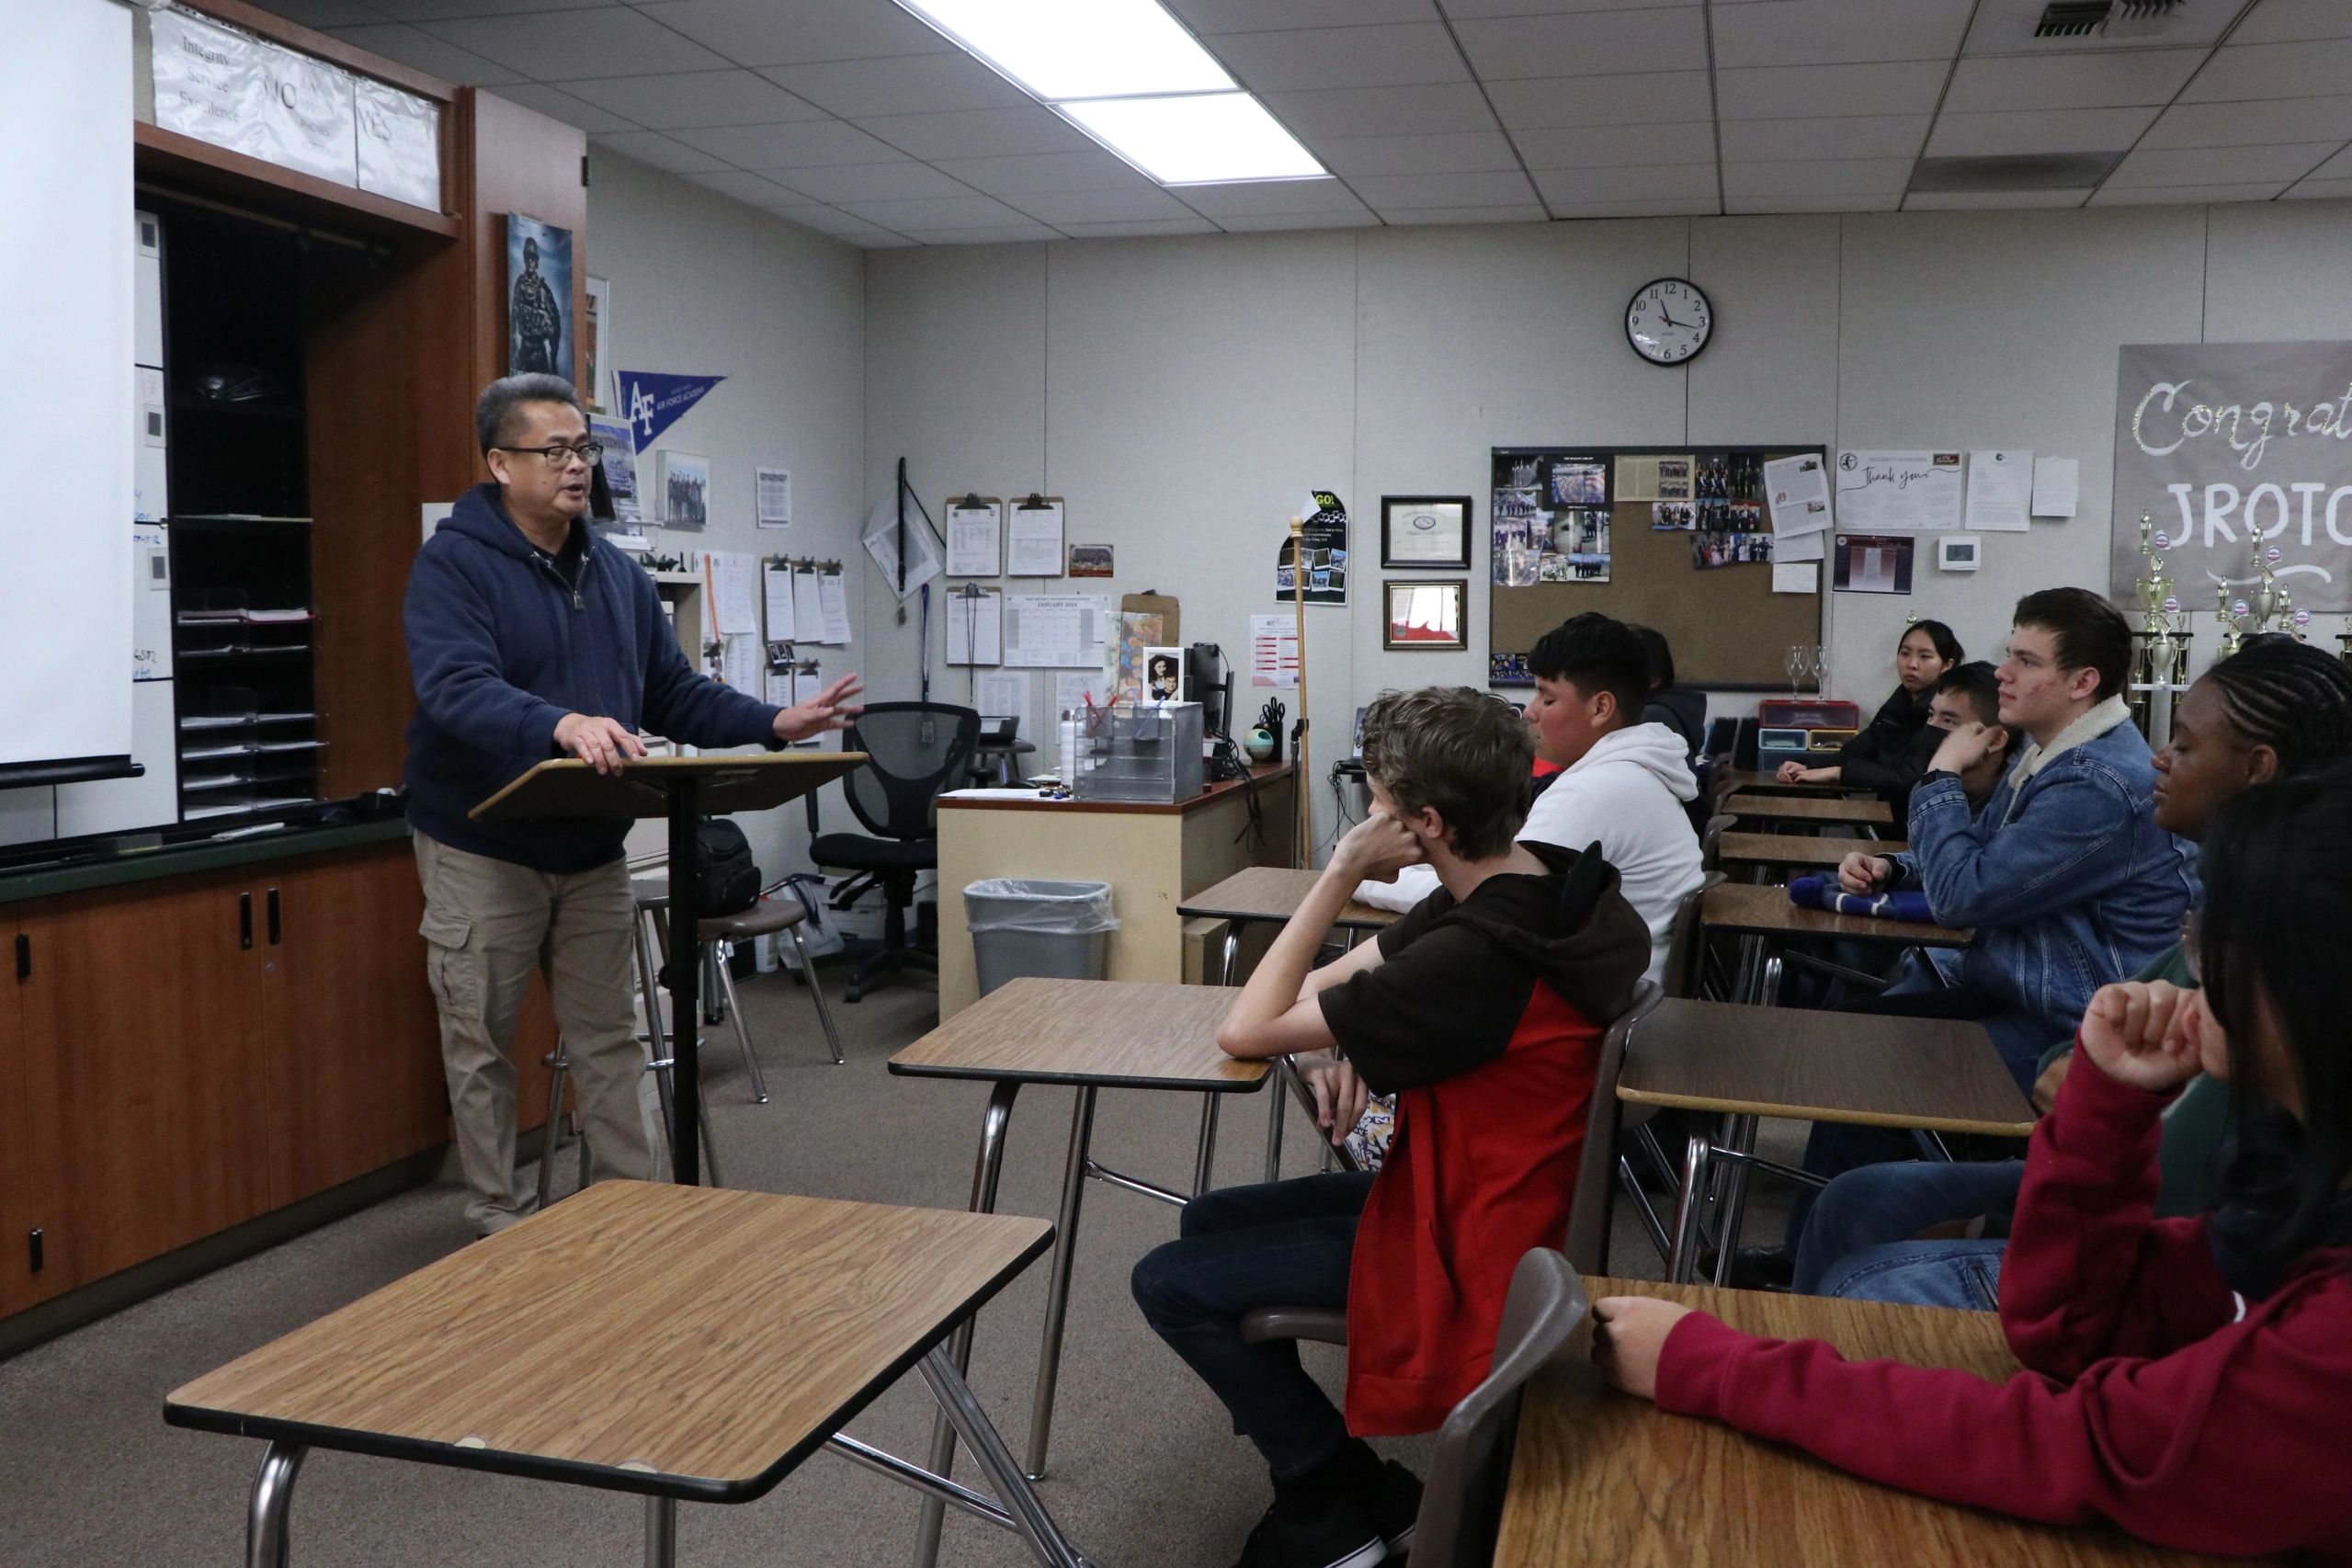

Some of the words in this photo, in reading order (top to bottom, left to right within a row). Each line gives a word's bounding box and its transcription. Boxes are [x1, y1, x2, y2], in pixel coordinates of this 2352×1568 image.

[183, 36, 231, 66] Integrity
[187, 66, 229, 93] Service
[264, 77, 297, 110] NO
[179, 91, 240, 122] Excellence
[359, 108, 392, 142] YES
[1650, 289, 1659, 300] 11
[1665, 283, 1676, 294] 12
[1683, 289, 1688, 300] 1
[1635, 300, 1646, 312] 10
[1694, 300, 1701, 312] 2
[1631, 316, 1639, 326] 9
[1699, 316, 1706, 328] 3
[1692, 332, 1699, 343] 4
[1649, 345, 1655, 356] 7
[1664, 348, 1671, 359] 6
[1679, 345, 1687, 356] 5
[656, 401, 666, 411] AIR
[665, 393, 683, 407] FORCE
[683, 386, 704, 401] ACADEMY
[630, 381, 654, 437] AF
[1862, 465, 1895, 485] Thank
[1898, 469, 1928, 490] you
[1315, 494, 1335, 505] GO!
